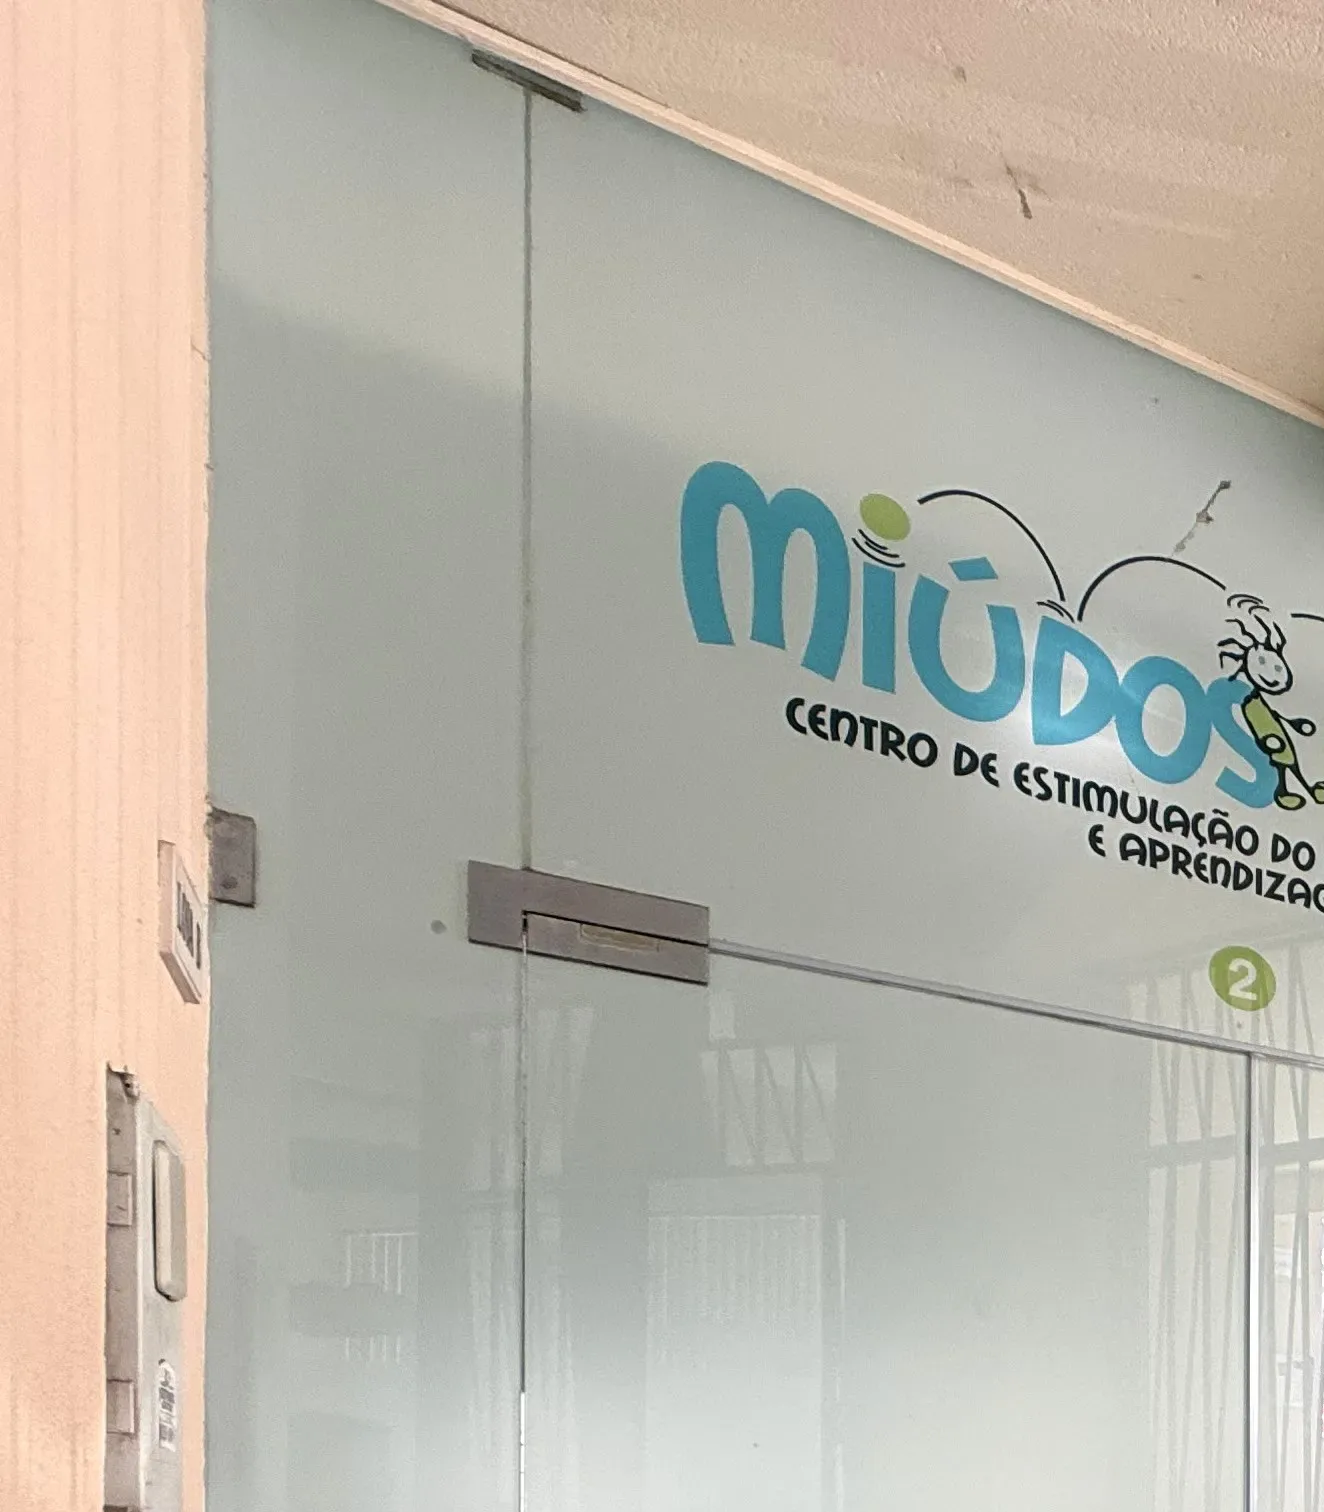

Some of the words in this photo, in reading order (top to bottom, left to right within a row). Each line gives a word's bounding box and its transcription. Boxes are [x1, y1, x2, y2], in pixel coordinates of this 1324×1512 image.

[786, 697, 938, 768] CENTRO
[953, 742, 1000, 788] DE
[1013, 762, 1260, 857] ESTIMULAÇÃO
[1271, 822, 1316, 872] DO
[1088, 823, 1107, 857] E
[1228, 957, 1257, 1001] 2
